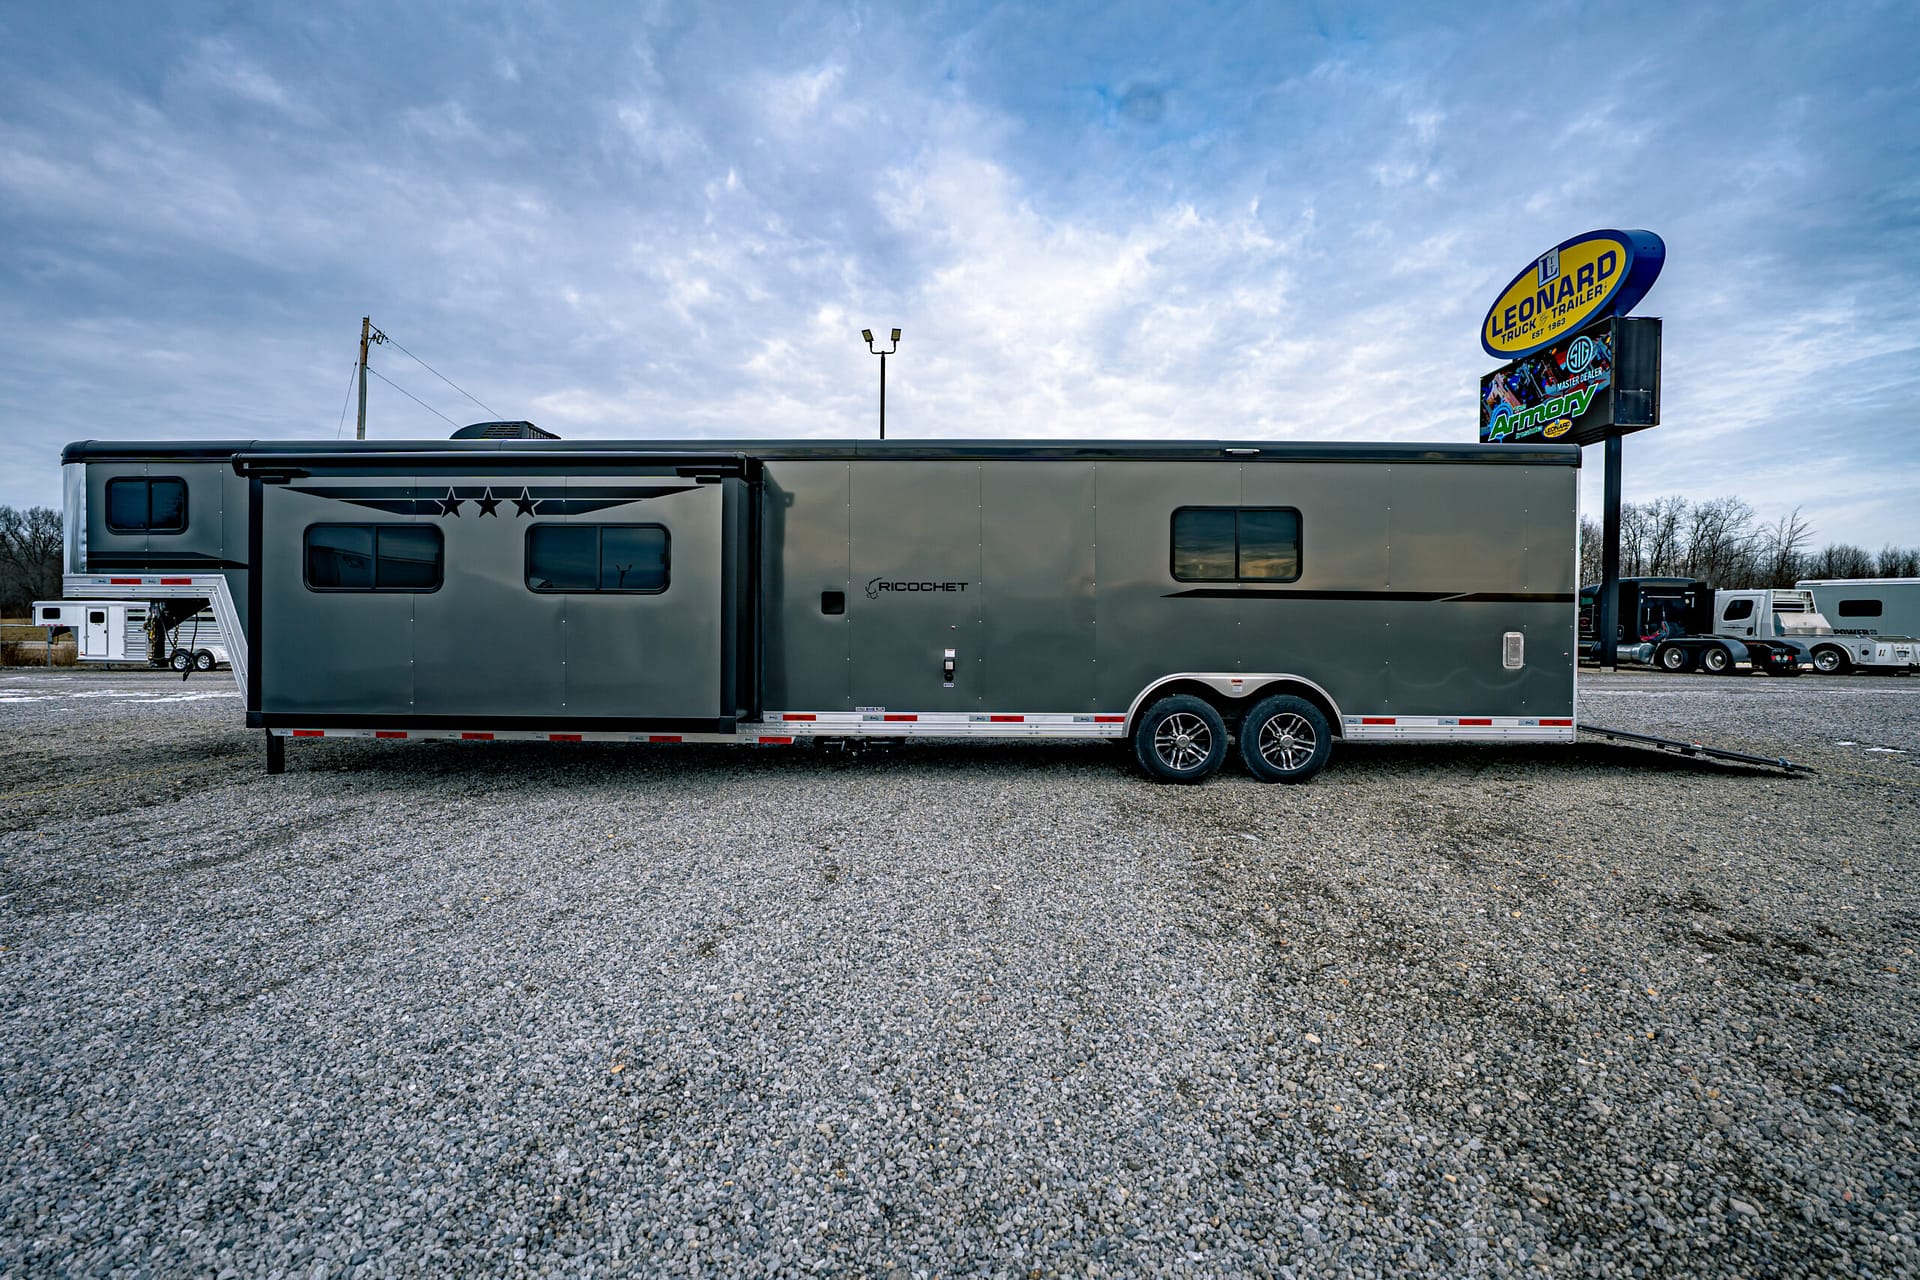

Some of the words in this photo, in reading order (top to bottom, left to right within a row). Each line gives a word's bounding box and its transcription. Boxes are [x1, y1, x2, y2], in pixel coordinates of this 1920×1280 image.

[1491, 250, 1617, 338] LEONARD
[1501, 318, 1537, 345] TRUCK
[1552, 284, 1603, 319] TRAILER
[1532, 328, 1544, 339] EST
[1570, 341, 1589, 369] SIG
[1557, 374, 1580, 390] MASTER
[1580, 367, 1603, 383] DEALER
[1488, 383, 1599, 441] Armory
[878, 582, 969, 592] RICOCHET
